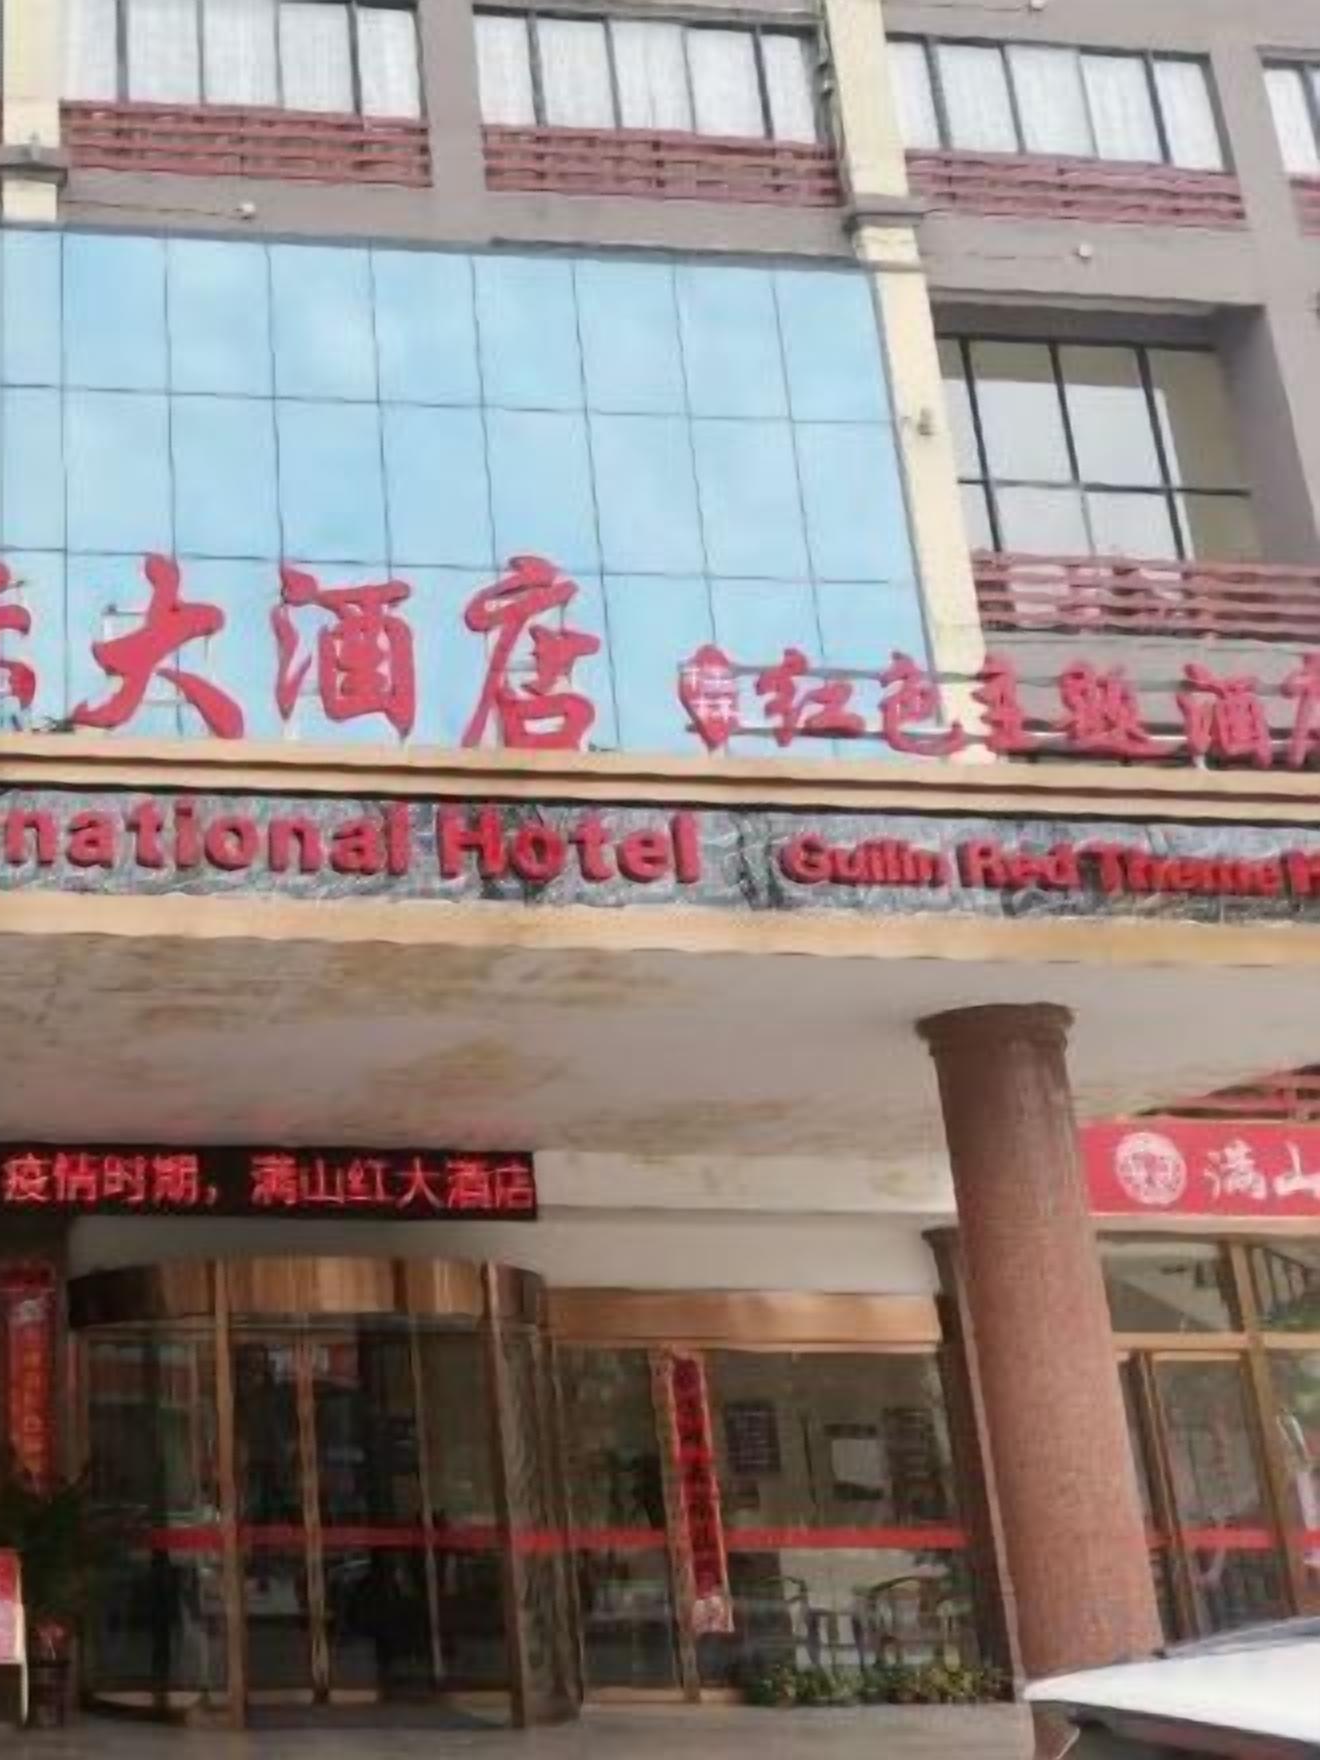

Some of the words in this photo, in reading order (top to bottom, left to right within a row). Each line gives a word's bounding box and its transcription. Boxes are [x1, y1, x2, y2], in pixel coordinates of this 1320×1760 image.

[437, 804, 702, 883] Hotel
[779, 830, 950, 890] Guilin
[956, 836, 1080, 890] Red
